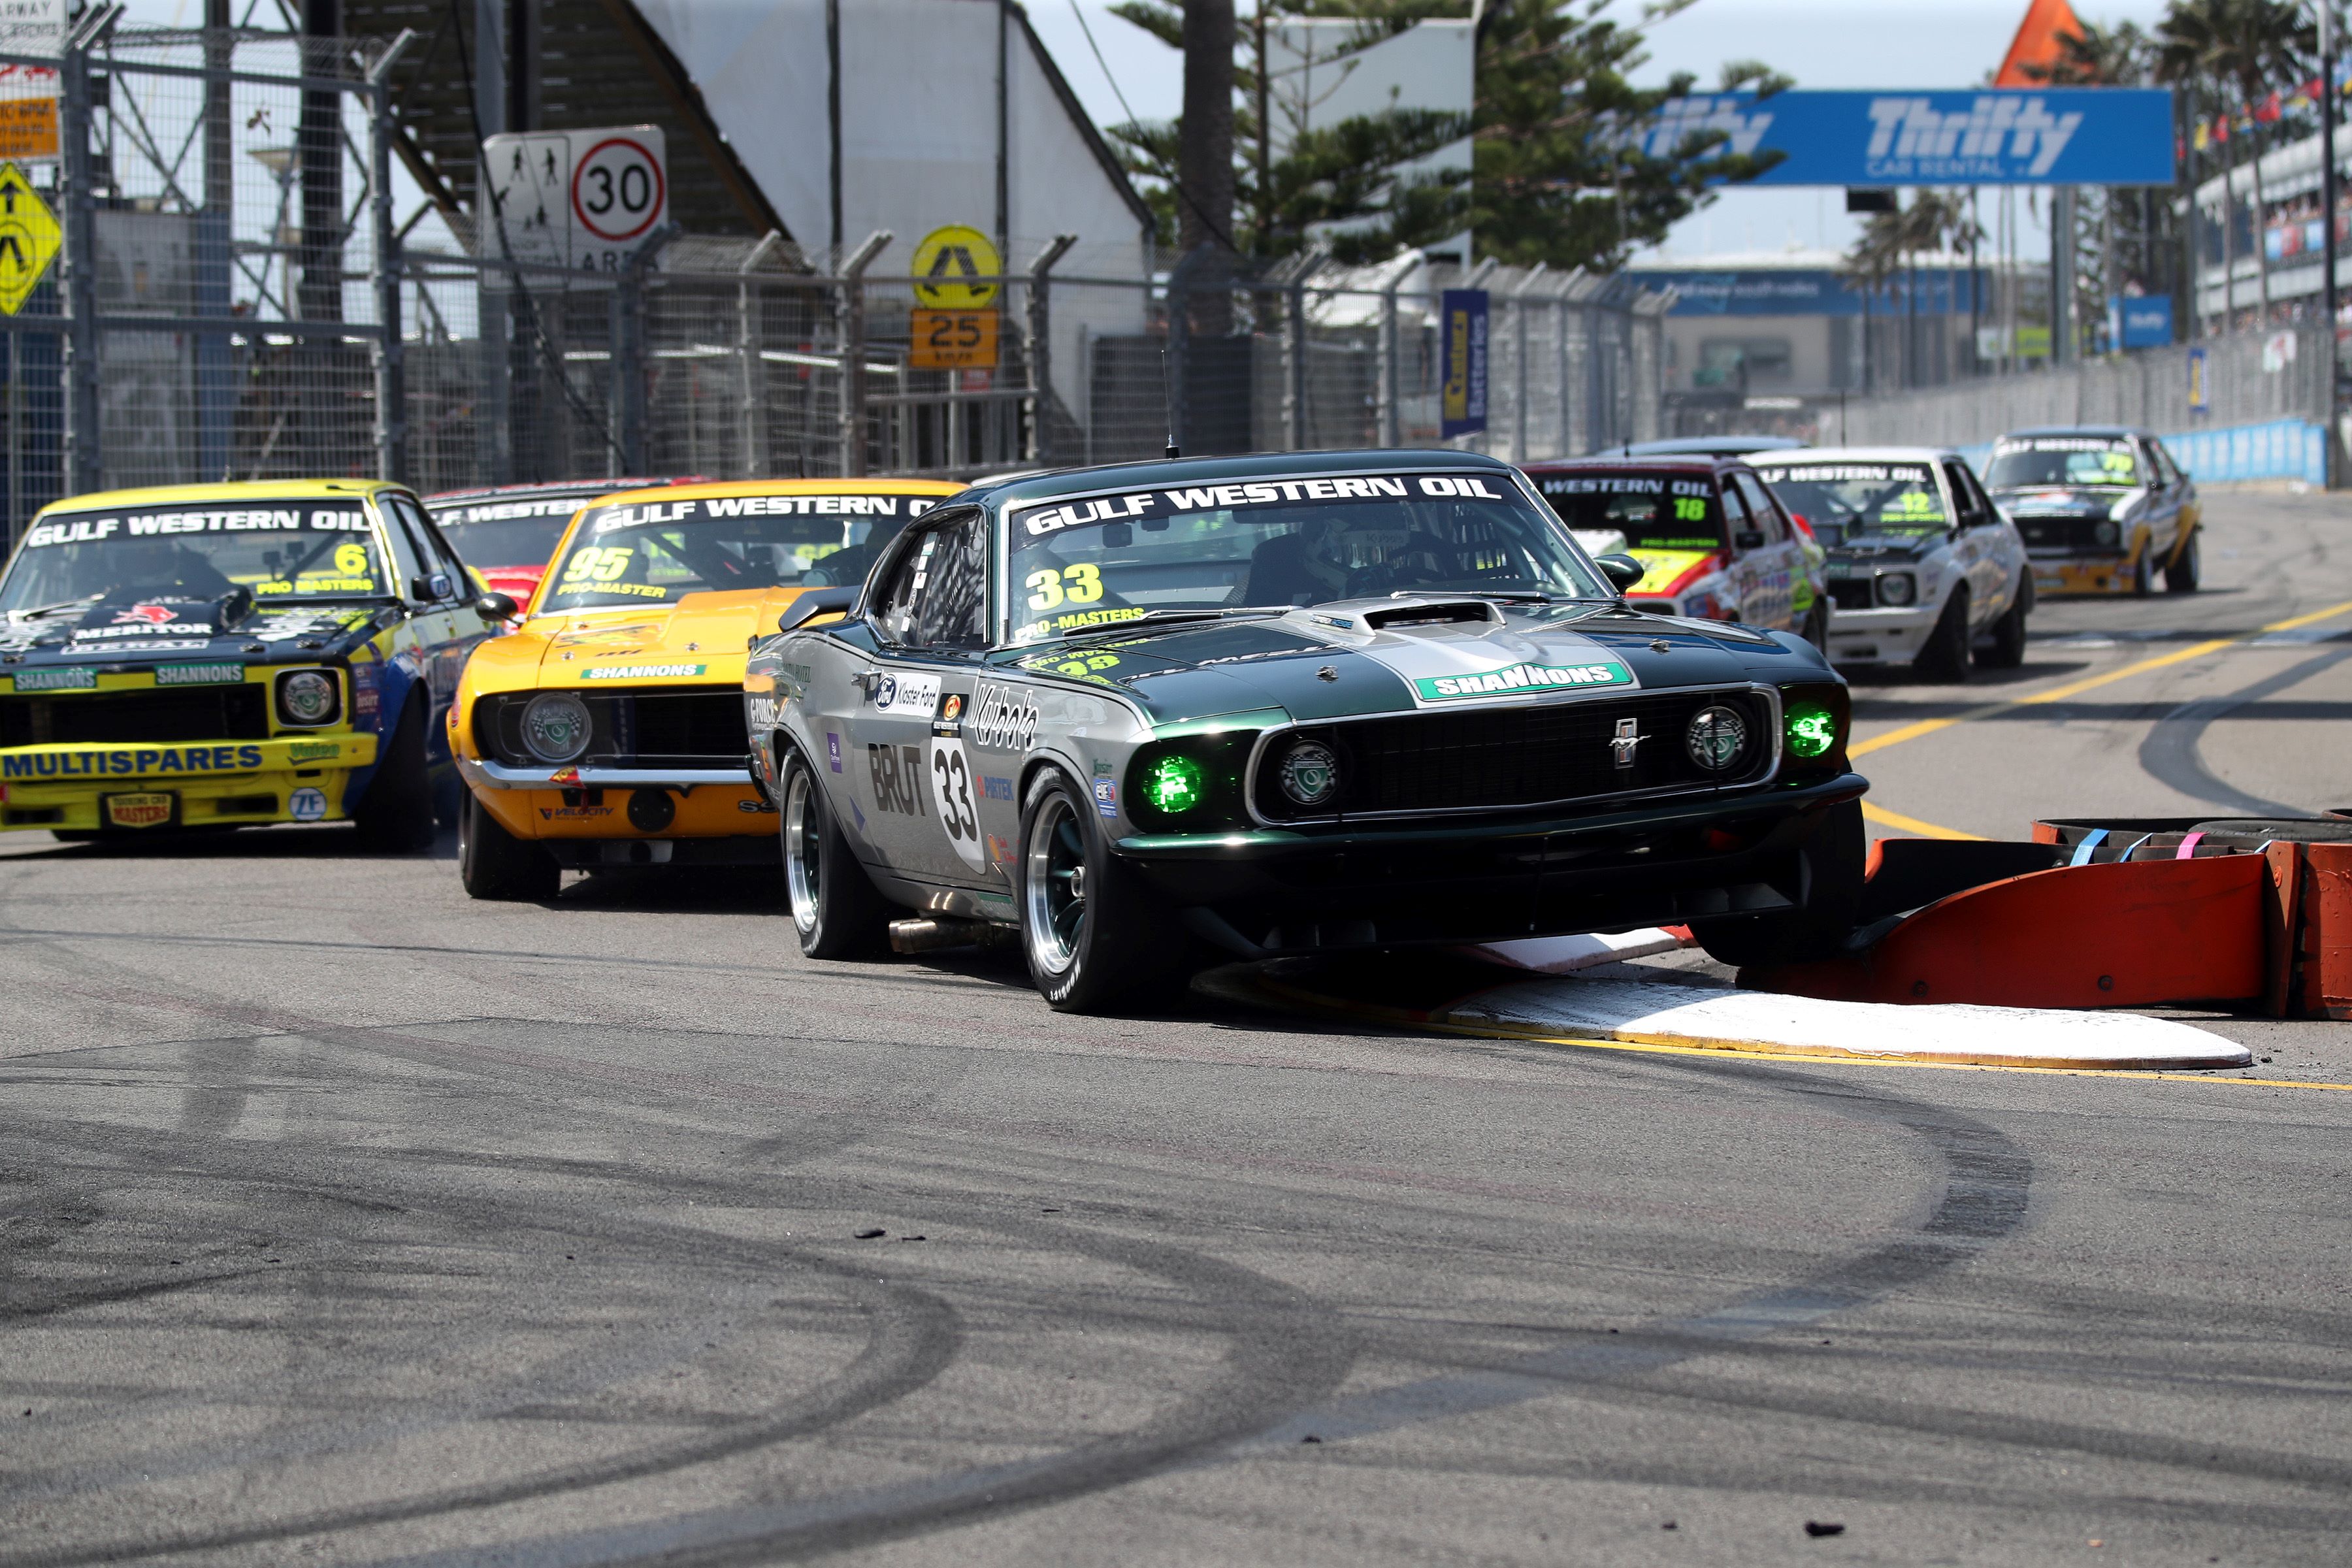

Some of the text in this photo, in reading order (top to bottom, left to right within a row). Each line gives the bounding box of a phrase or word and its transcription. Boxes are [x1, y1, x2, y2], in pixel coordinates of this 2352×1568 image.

[1867, 97, 2083, 176] Thrifty
[1865, 159, 2006, 179] CAR RENTAL
[587, 165, 650, 214] 30
[929, 316, 981, 347] 25
[1789, 466, 1888, 482] WESTERN
[1891, 467, 1927, 482] OIL
[1544, 478, 1713, 497] WESTERN OIL
[468, 499, 589, 523] WESTER
[596, 501, 695, 532] GULF
[706, 497, 896, 517] WESTERN
[1026, 476, 1503, 536] GULF WESTERN OIL
[1673, 498, 1707, 521] 18
[1900, 493, 1929, 512] 12
[27, 510, 372, 548] GULF WESTERN OIL
[335, 544, 368, 575] 6
[563, 546, 634, 581] 95
[257, 578, 374, 595] PRO MASTERS
[557, 583, 666, 599] PRO-MASTER
[1025, 563, 1103, 611] 33
[75, 623, 212, 640] MERITOR
[1015, 608, 1145, 643] PRO-MASTERS
[16, 671, 95, 690] SHANNONS
[157, 664, 242, 685] SHANNONS
[590, 664, 697, 679] SHANNONS
[1436, 664, 1614, 695] SHANNONS
[896, 681, 921, 705] Kloster
[920, 684, 939, 708] Ford
[751, 698, 776, 723] G-FORCE
[969, 683, 1039, 751] Kubota
[3, 744, 263, 777] MULTISPARES
[290, 743, 340, 757] Valeo
[868, 742, 926, 817] BRUT
[291, 793, 325, 815] ZF
[934, 749, 977, 842] 33
[555, 808, 614, 816] VELOCITY
